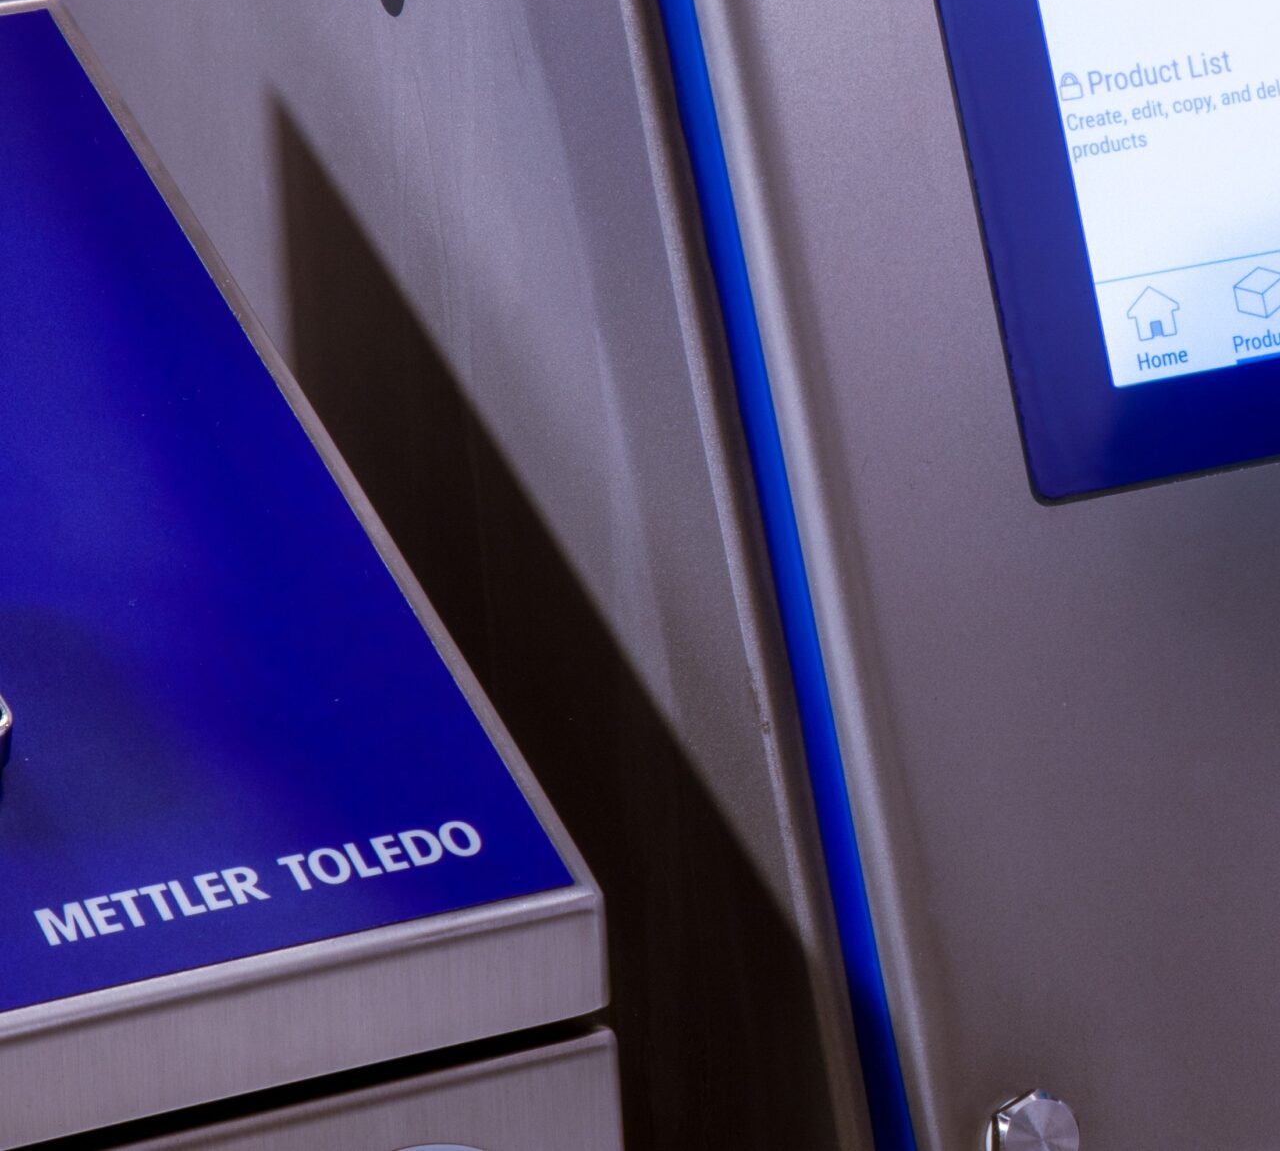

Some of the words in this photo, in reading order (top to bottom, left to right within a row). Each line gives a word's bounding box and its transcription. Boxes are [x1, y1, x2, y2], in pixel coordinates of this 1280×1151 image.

[1087, 58, 1183, 96] Product
[1187, 49, 1234, 81] List
[1066, 109, 1129, 132] Create,
[1131, 99, 1169, 120] edit,
[1172, 94, 1217, 115] copy,
[1221, 83, 1253, 107] and
[1072, 132, 1149, 164] products
[1137, 348, 1189, 372] Home
[33, 865, 272, 947] METTLER
[277, 820, 482, 891] TOLEDO
